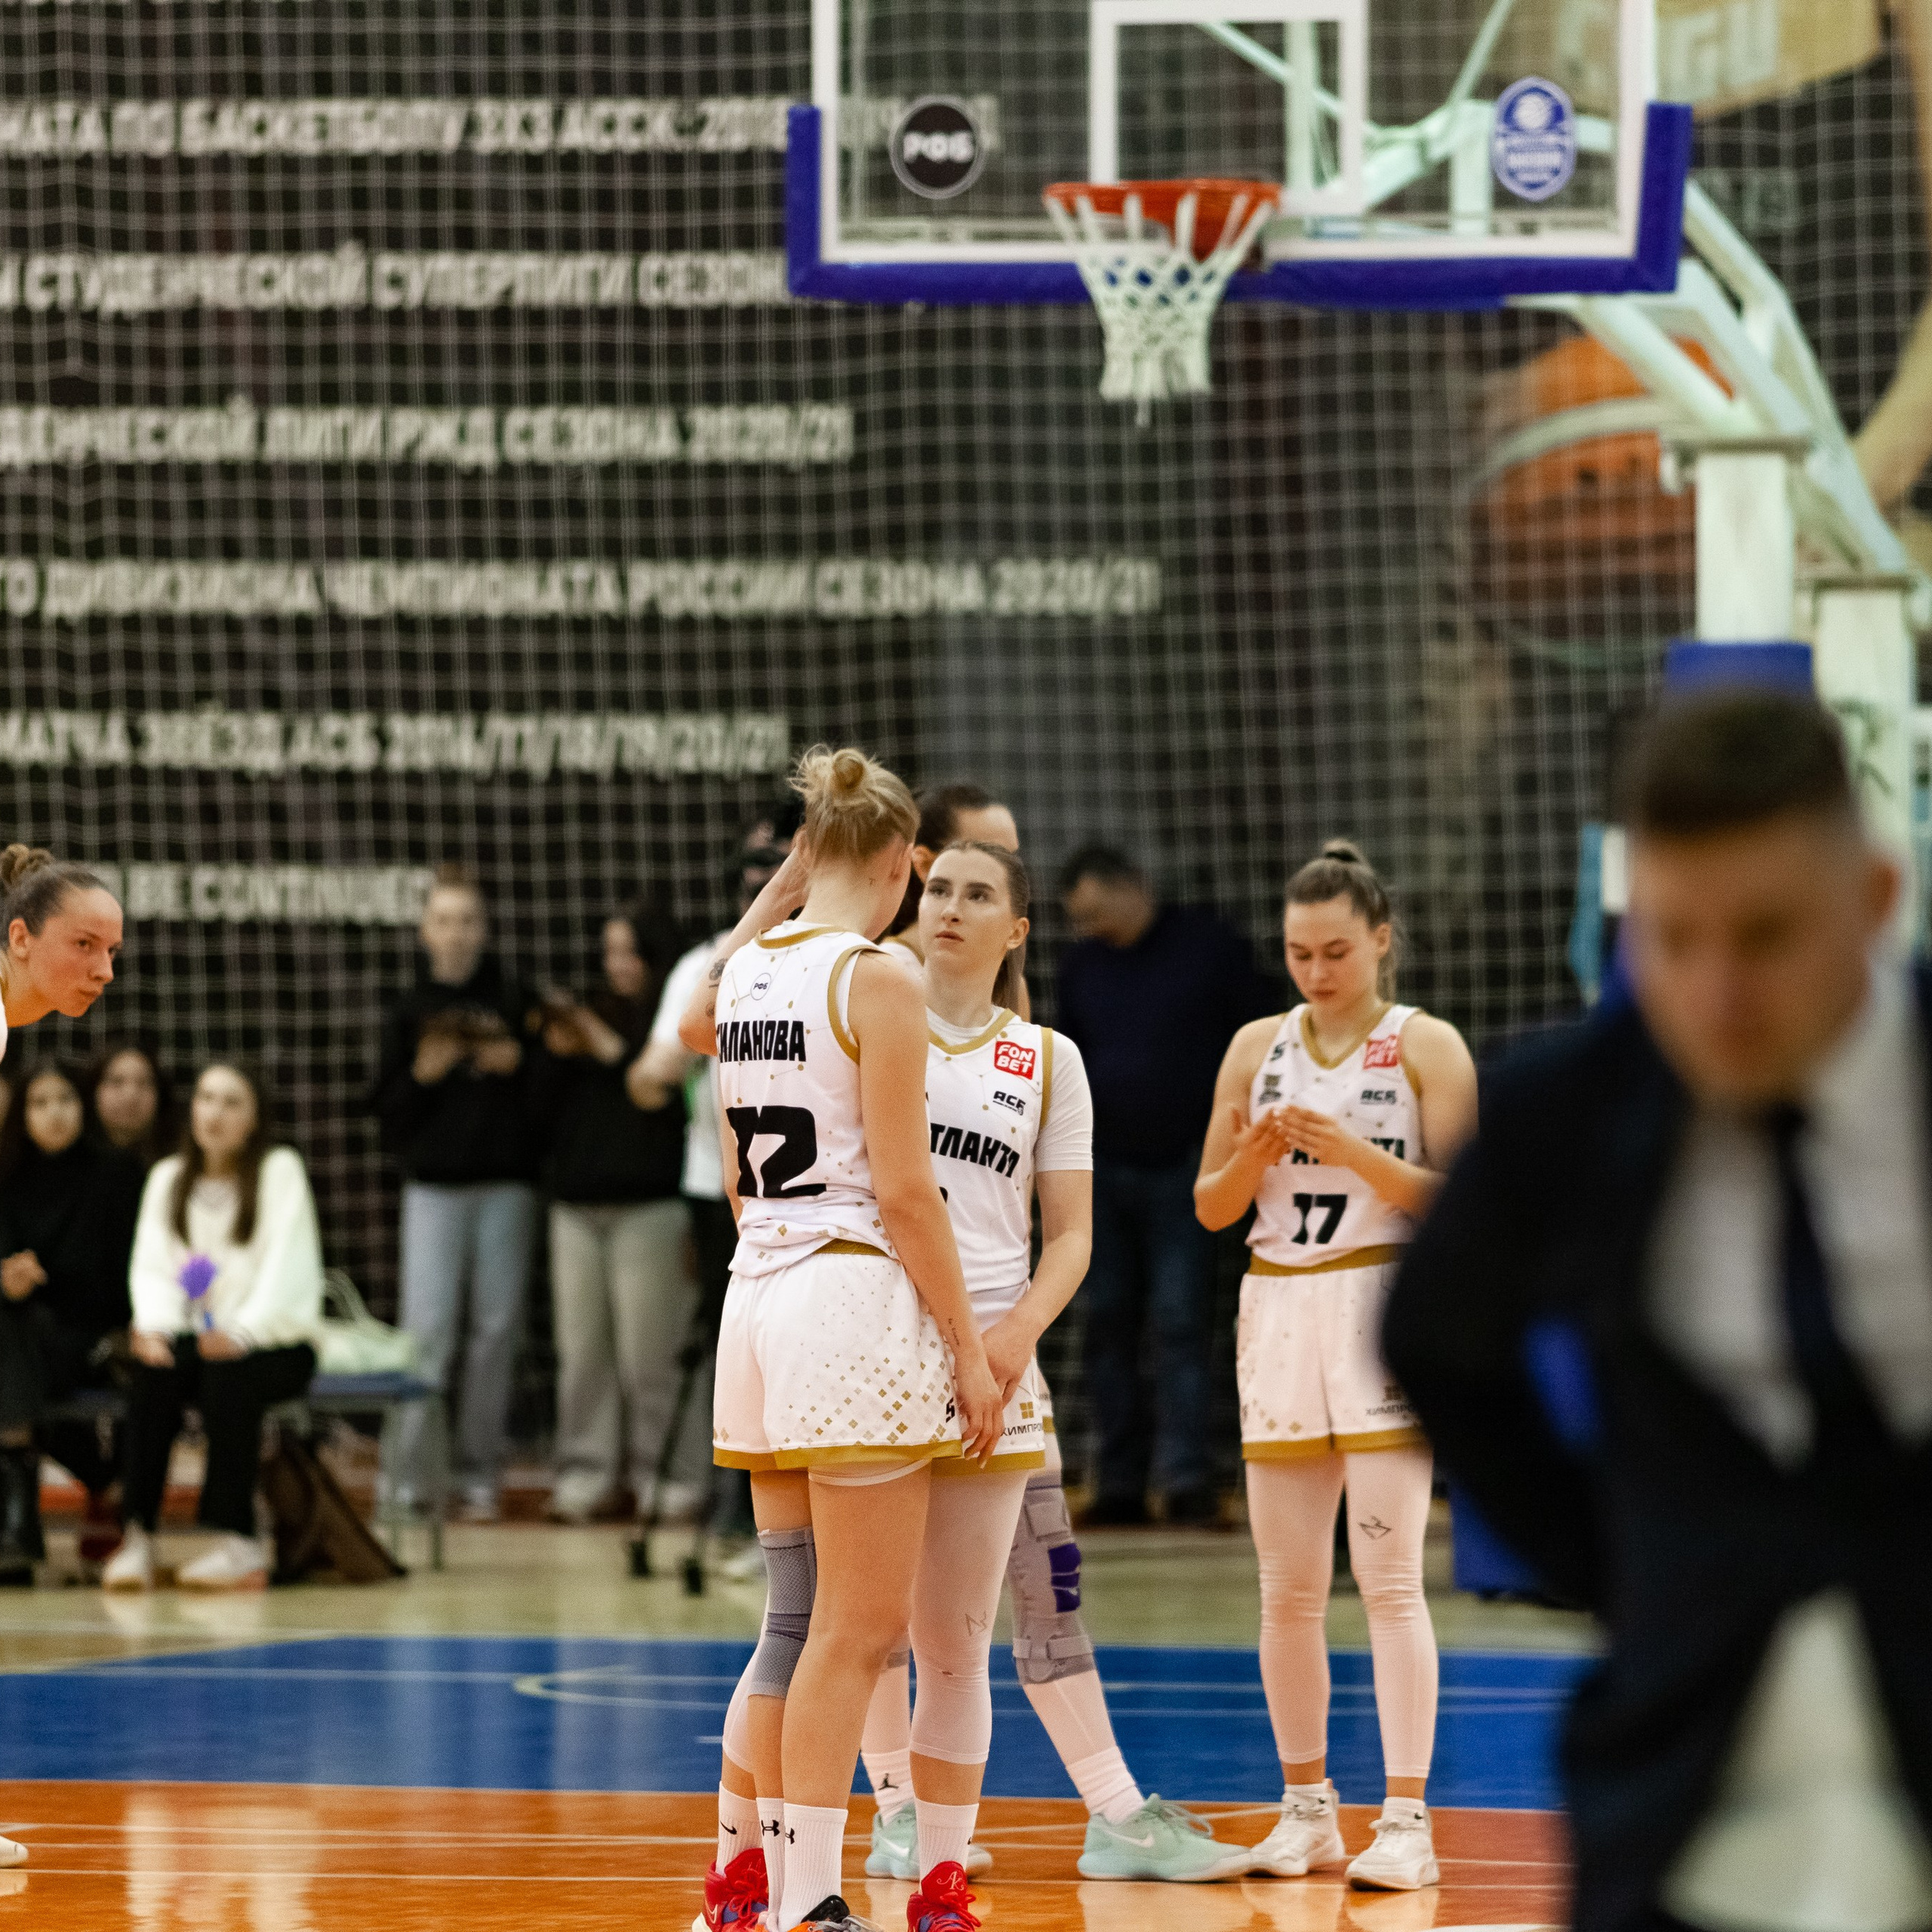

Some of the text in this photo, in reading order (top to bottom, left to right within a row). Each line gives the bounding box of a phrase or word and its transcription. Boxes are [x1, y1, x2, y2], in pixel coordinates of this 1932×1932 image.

[996, 1055, 1032, 1073] BET
[997, 1044, 1033, 1062] FON
[725, 1105, 827, 1198] 12
[1291, 1192, 1349, 1245] 17
